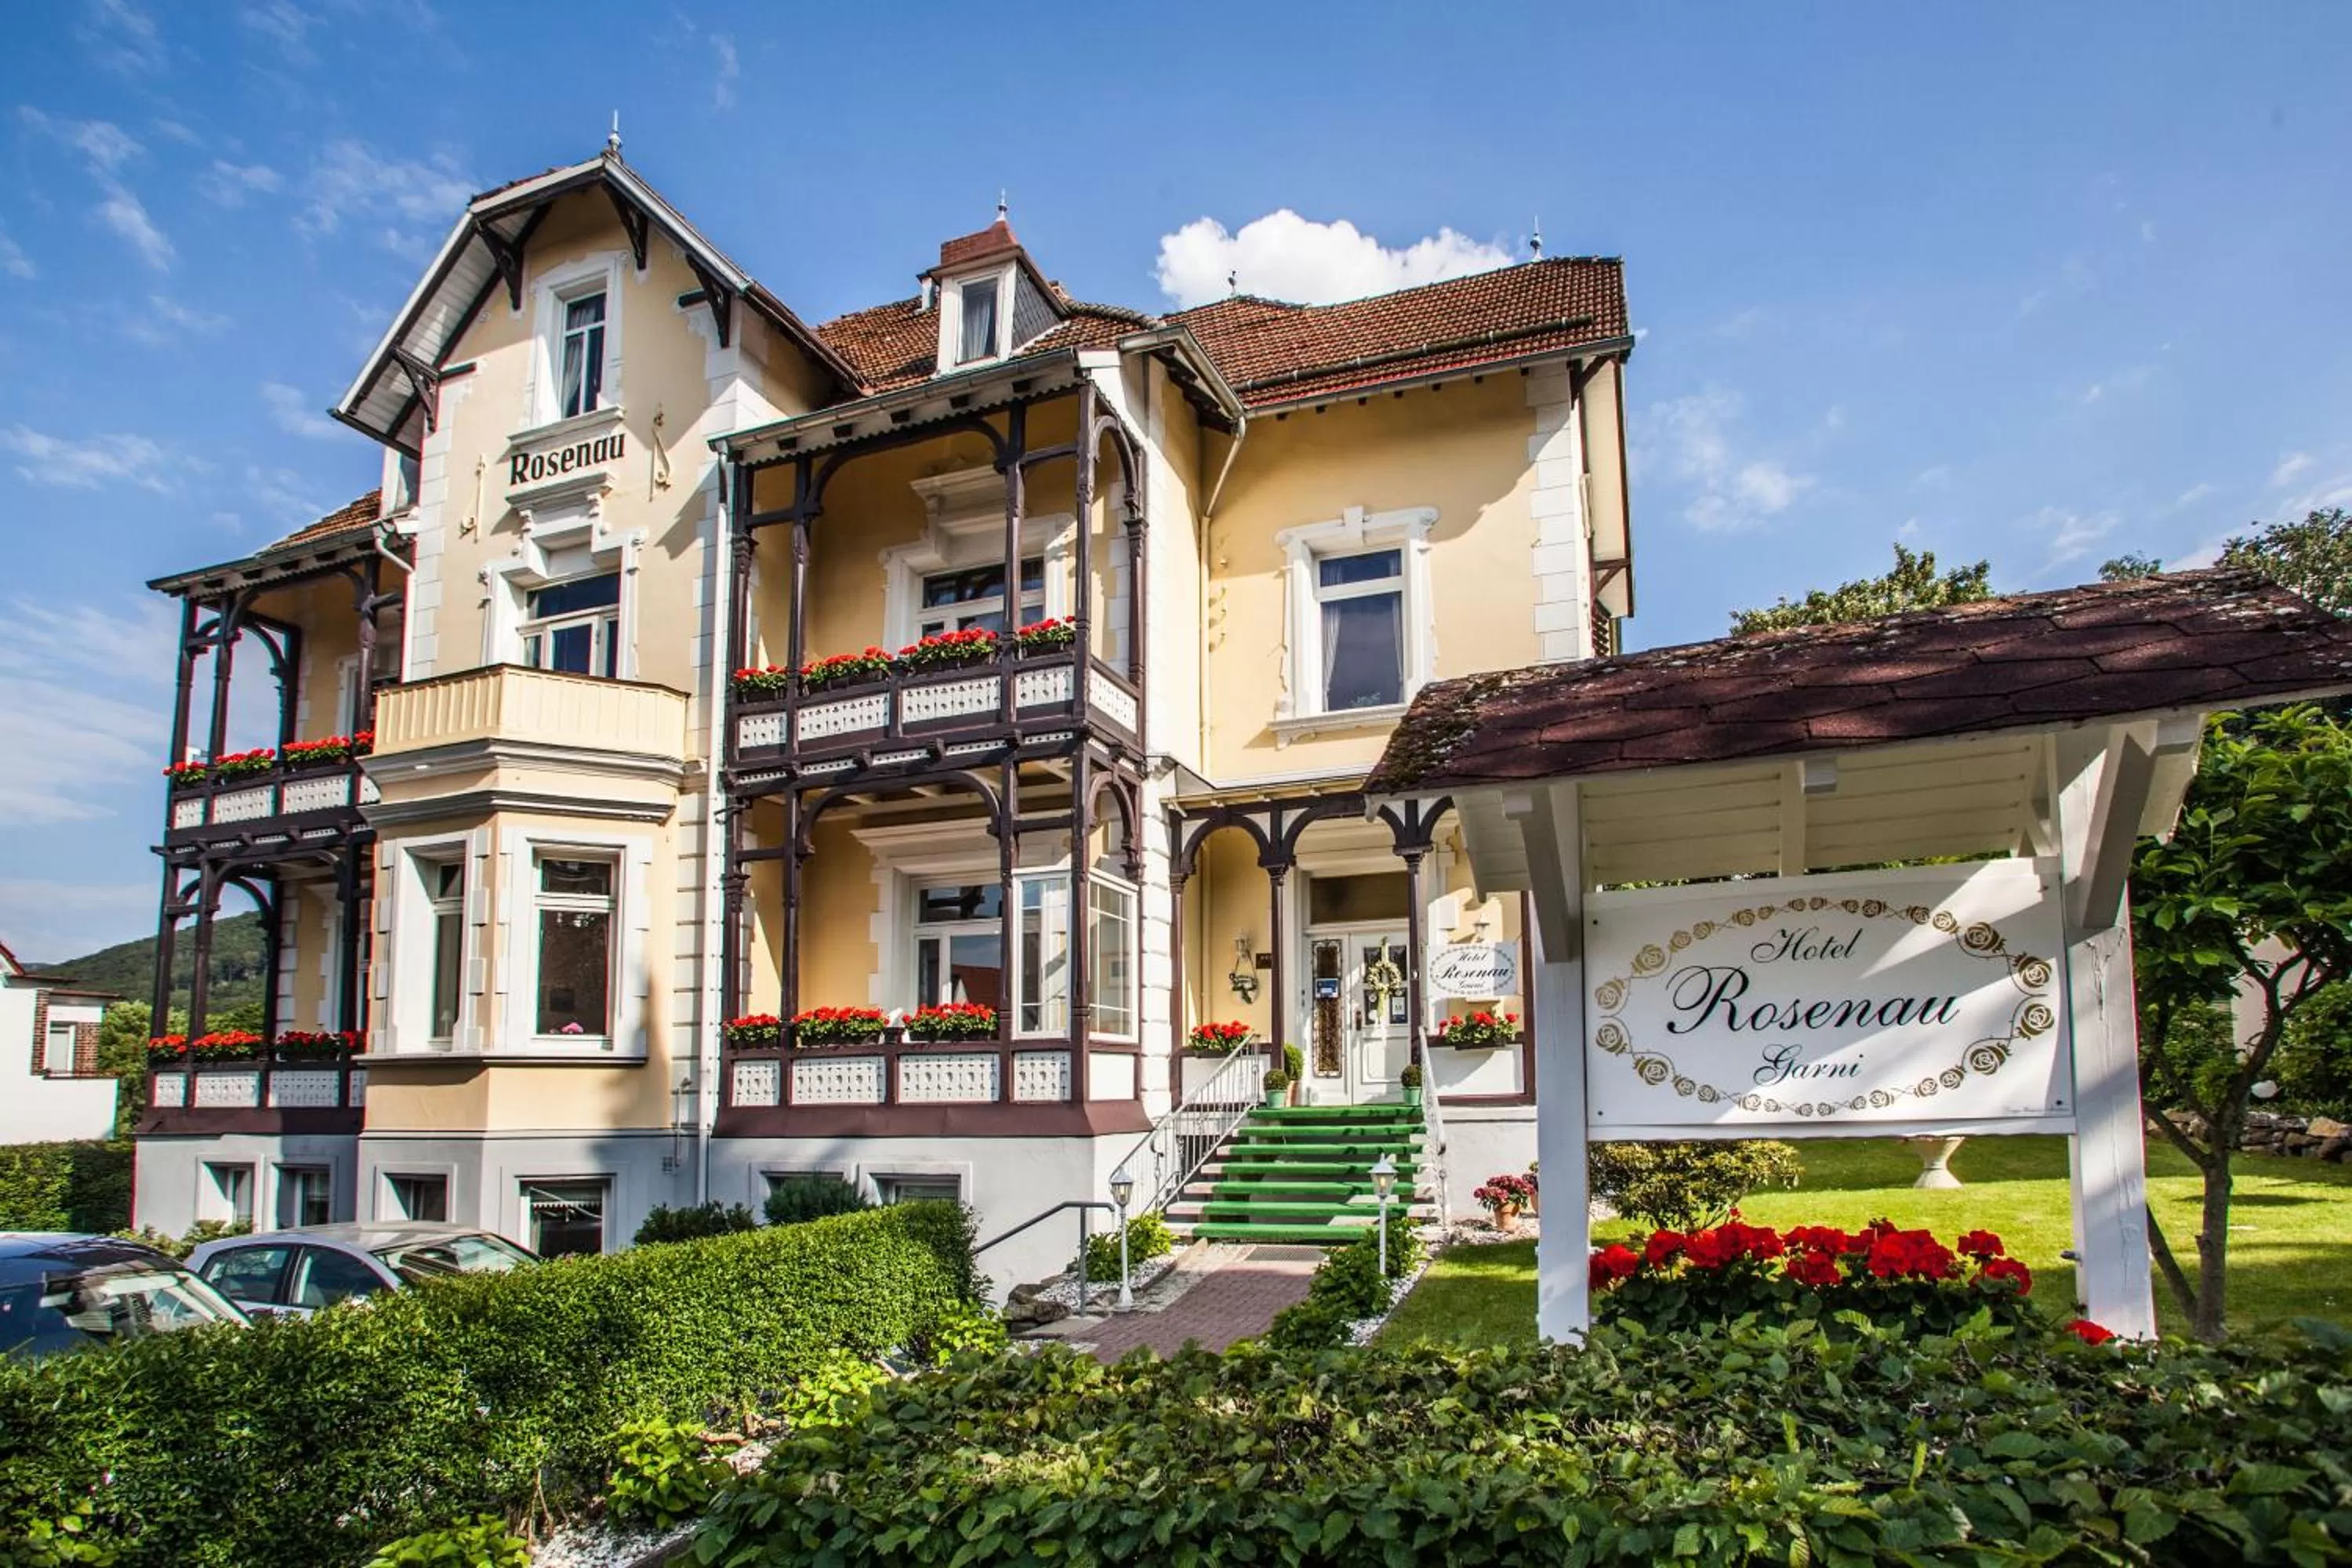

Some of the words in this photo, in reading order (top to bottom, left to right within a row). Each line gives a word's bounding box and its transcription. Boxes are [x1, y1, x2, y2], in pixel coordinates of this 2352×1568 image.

[510, 434, 625, 485] Rosenau
[1751, 927, 1864, 964] Hotel
[1436, 964, 1508, 979] Rosenau
[1665, 966, 1960, 1034] Rosenau
[1753, 1044, 1864, 1087] Garni
